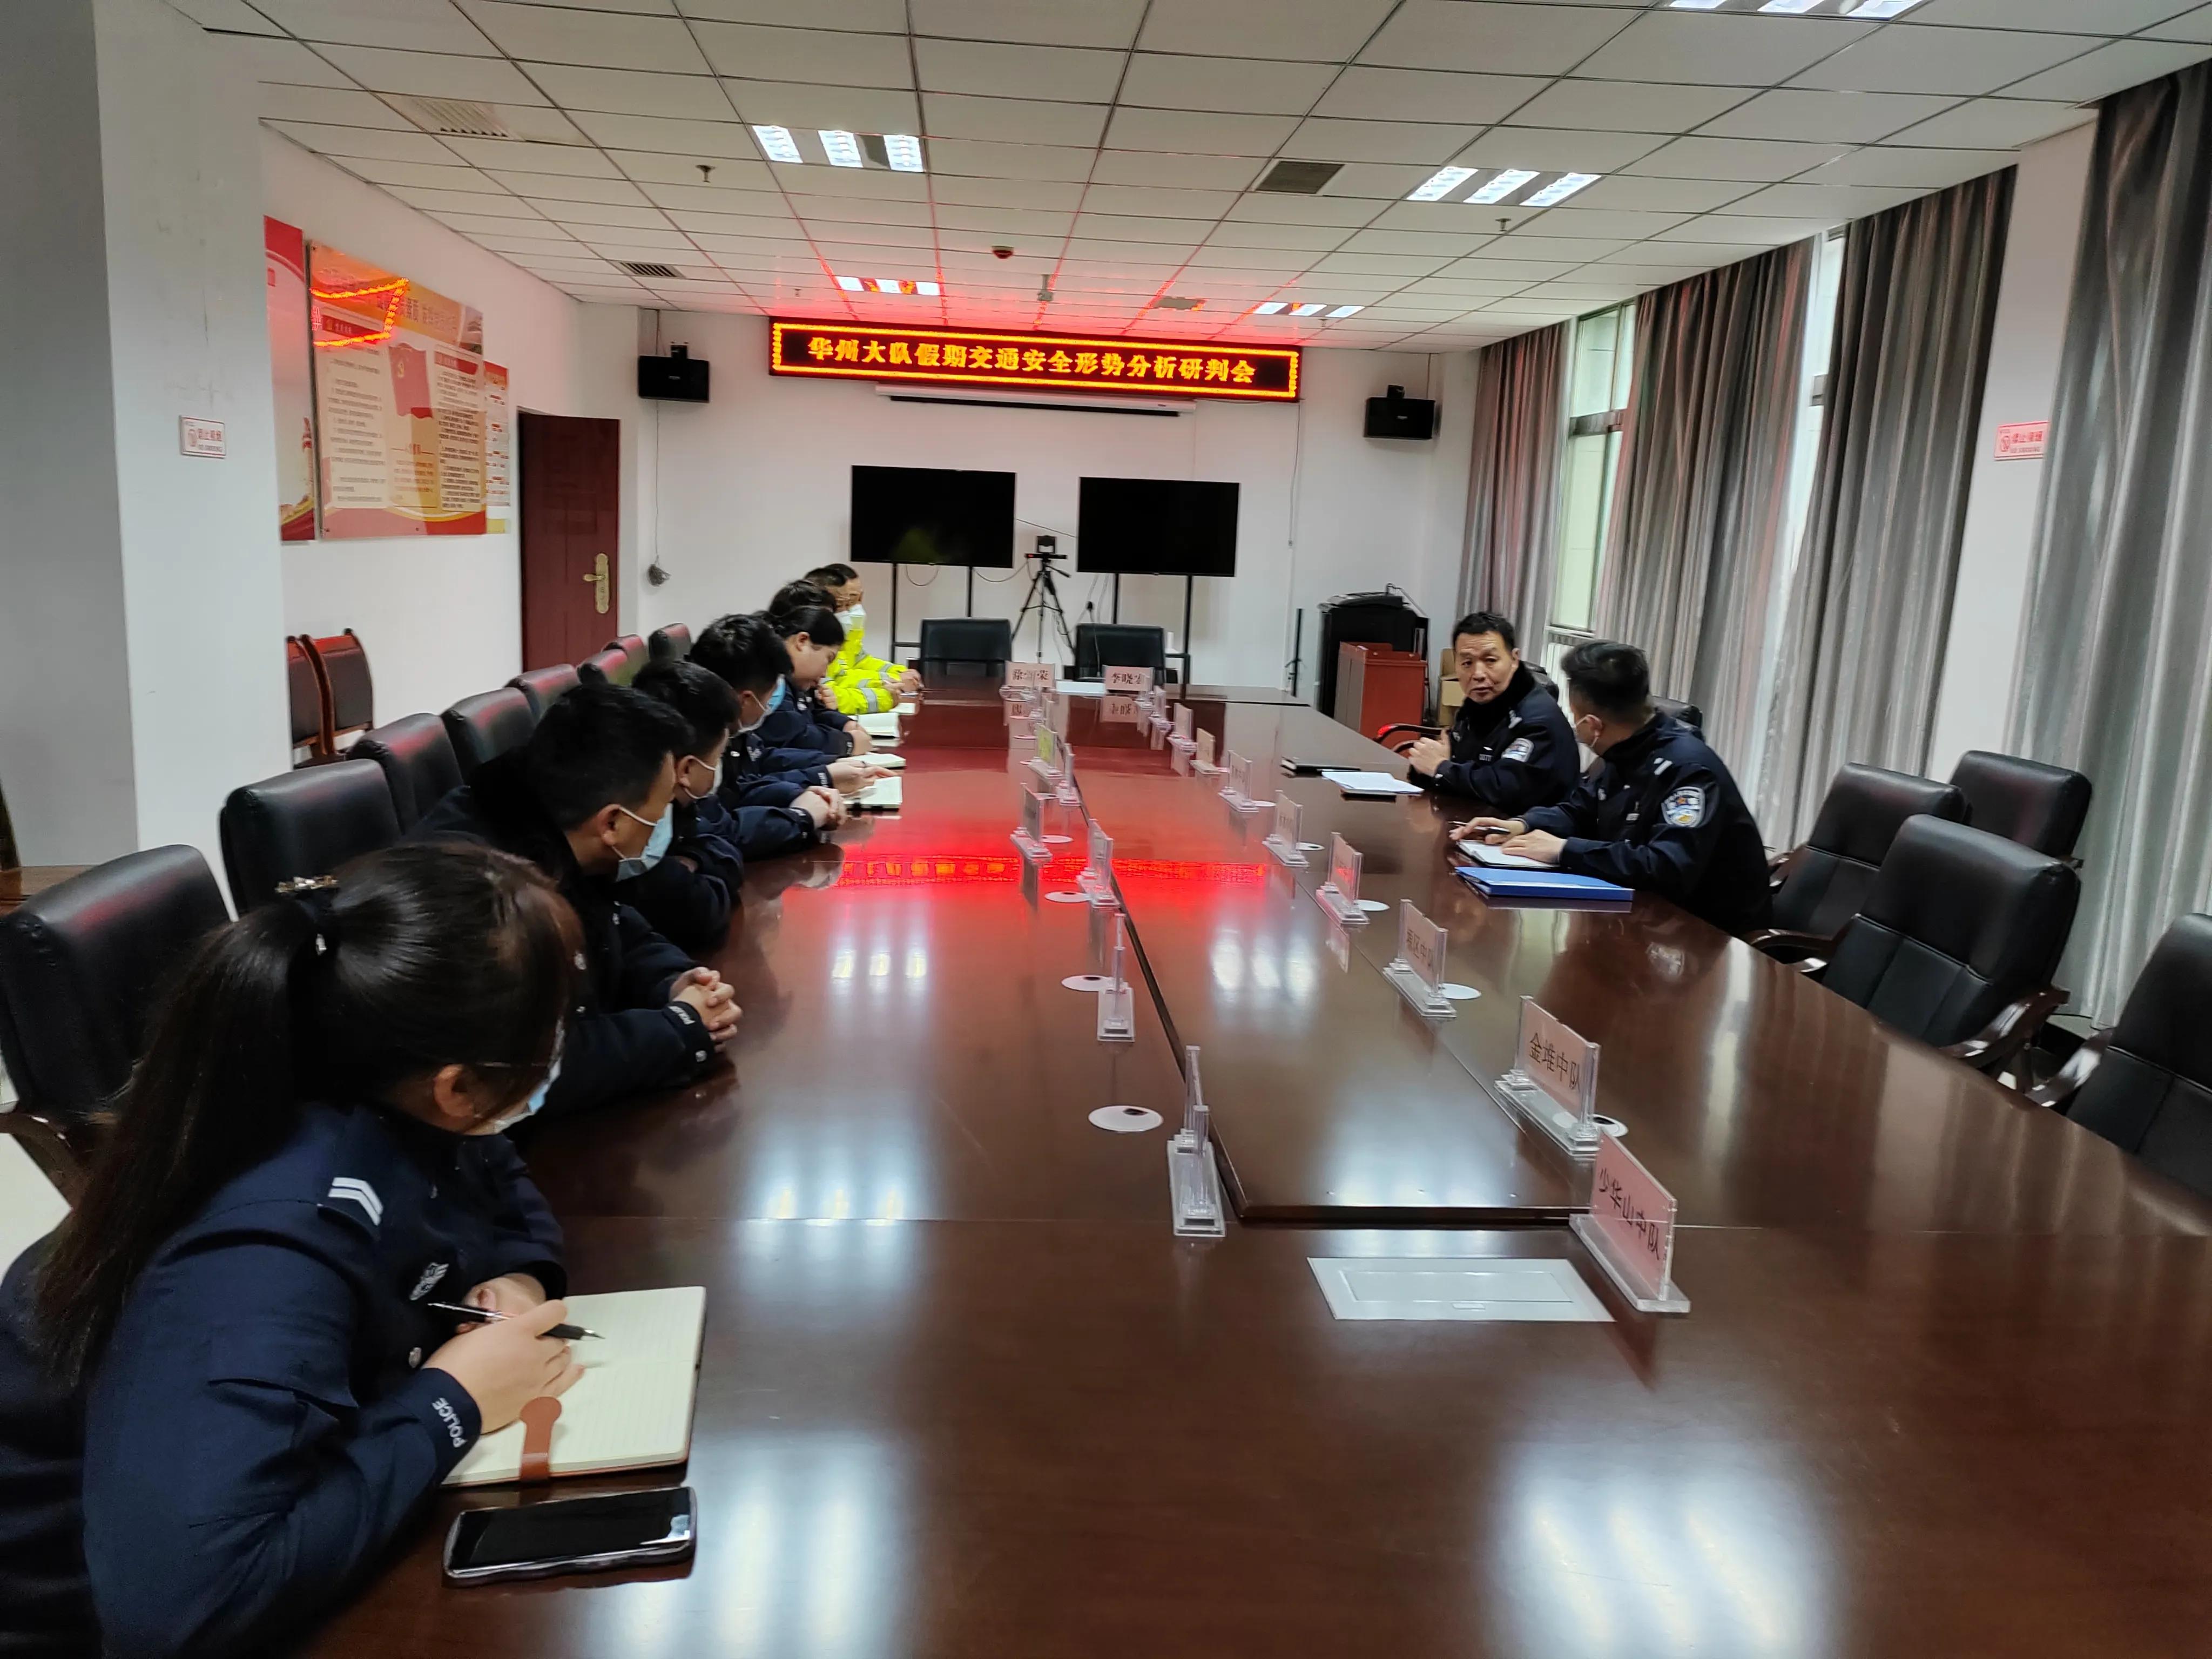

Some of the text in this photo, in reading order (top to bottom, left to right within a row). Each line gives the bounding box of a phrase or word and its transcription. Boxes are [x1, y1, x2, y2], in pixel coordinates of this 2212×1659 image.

[808, 338, 1256, 383] 华州大队假期交通安全形势分析研判会
[1529, 1032, 1581, 1092] 金堆中队
[1600, 1168, 1660, 1260] 少华山中队
[432, 1397, 467, 1447] POLICE
